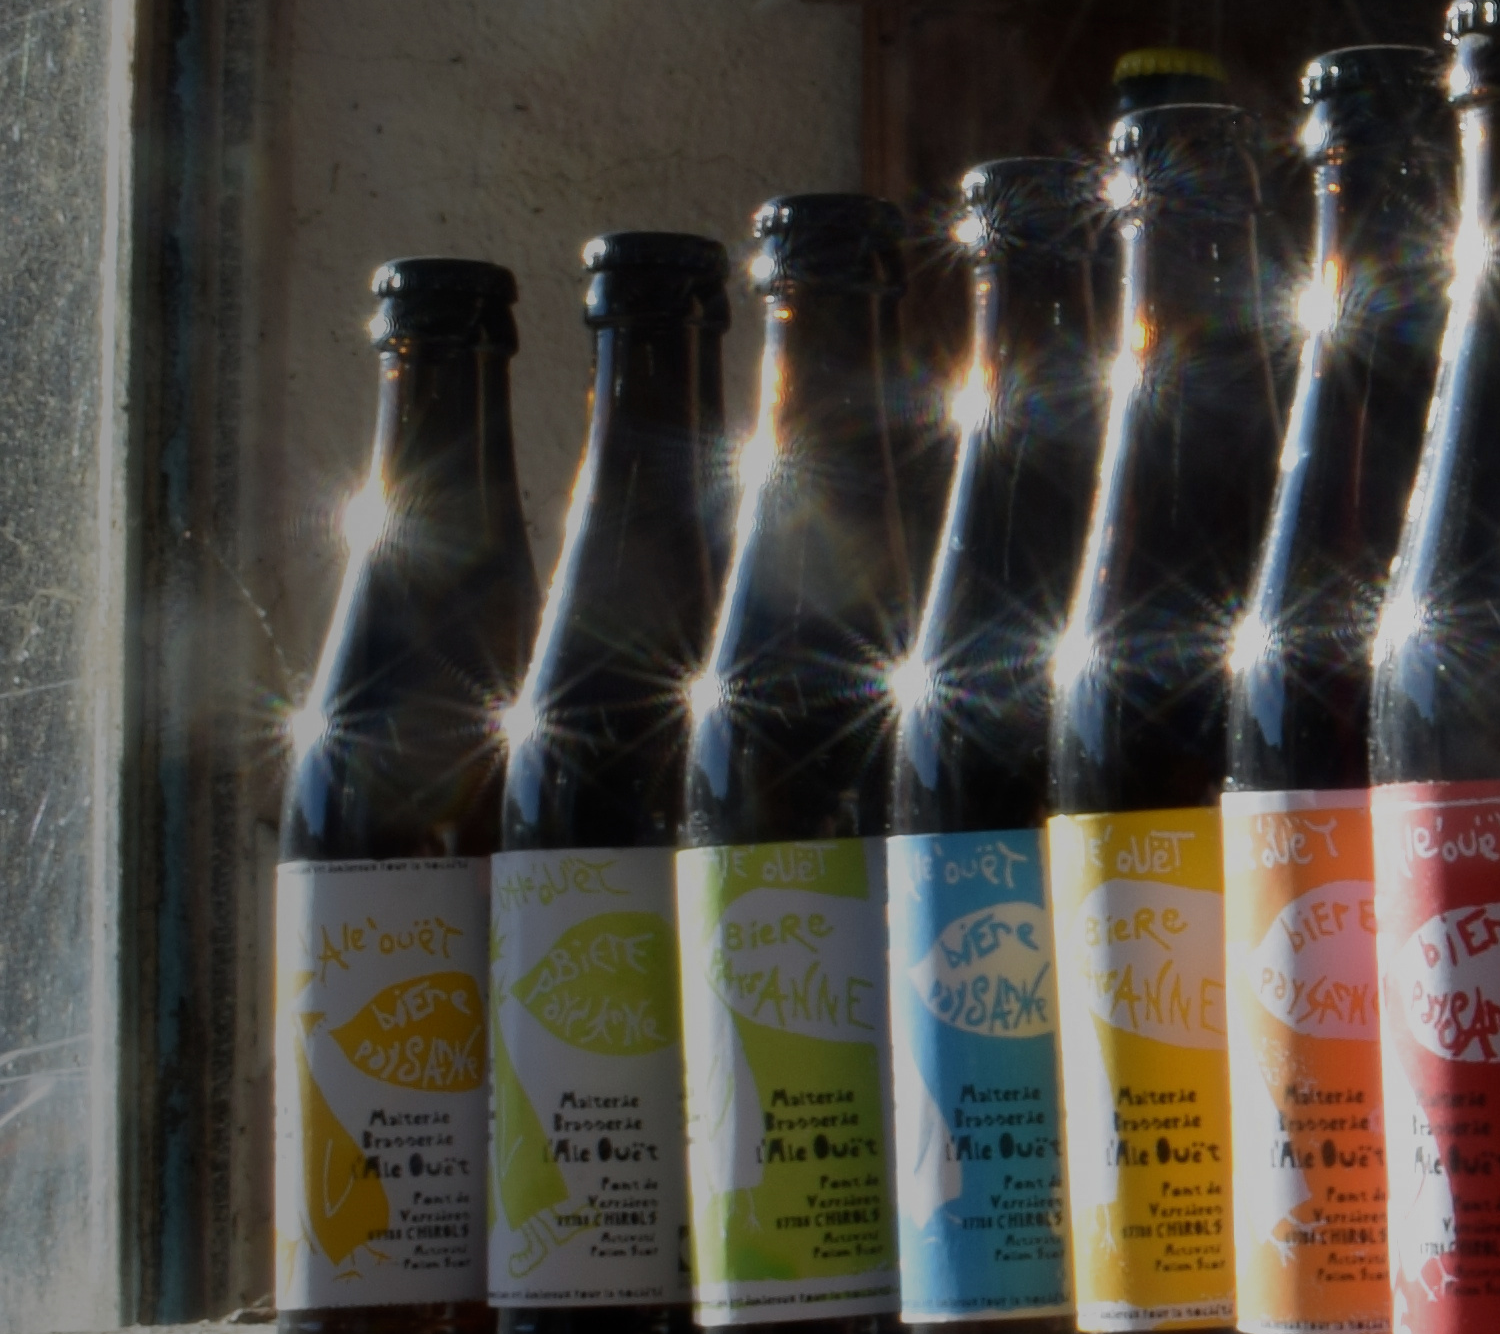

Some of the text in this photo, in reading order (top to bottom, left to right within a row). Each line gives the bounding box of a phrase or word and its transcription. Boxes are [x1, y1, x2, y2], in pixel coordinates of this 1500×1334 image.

[560, 1091, 640, 1109] Malterie
[960, 1084, 1041, 1103] Malterie
[1117, 1087, 1197, 1106] Malterie
[369, 1109, 450, 1127] Malterie
[553, 1113, 642, 1132] Brasserie
[362, 1130, 454, 1149] Brasserie
